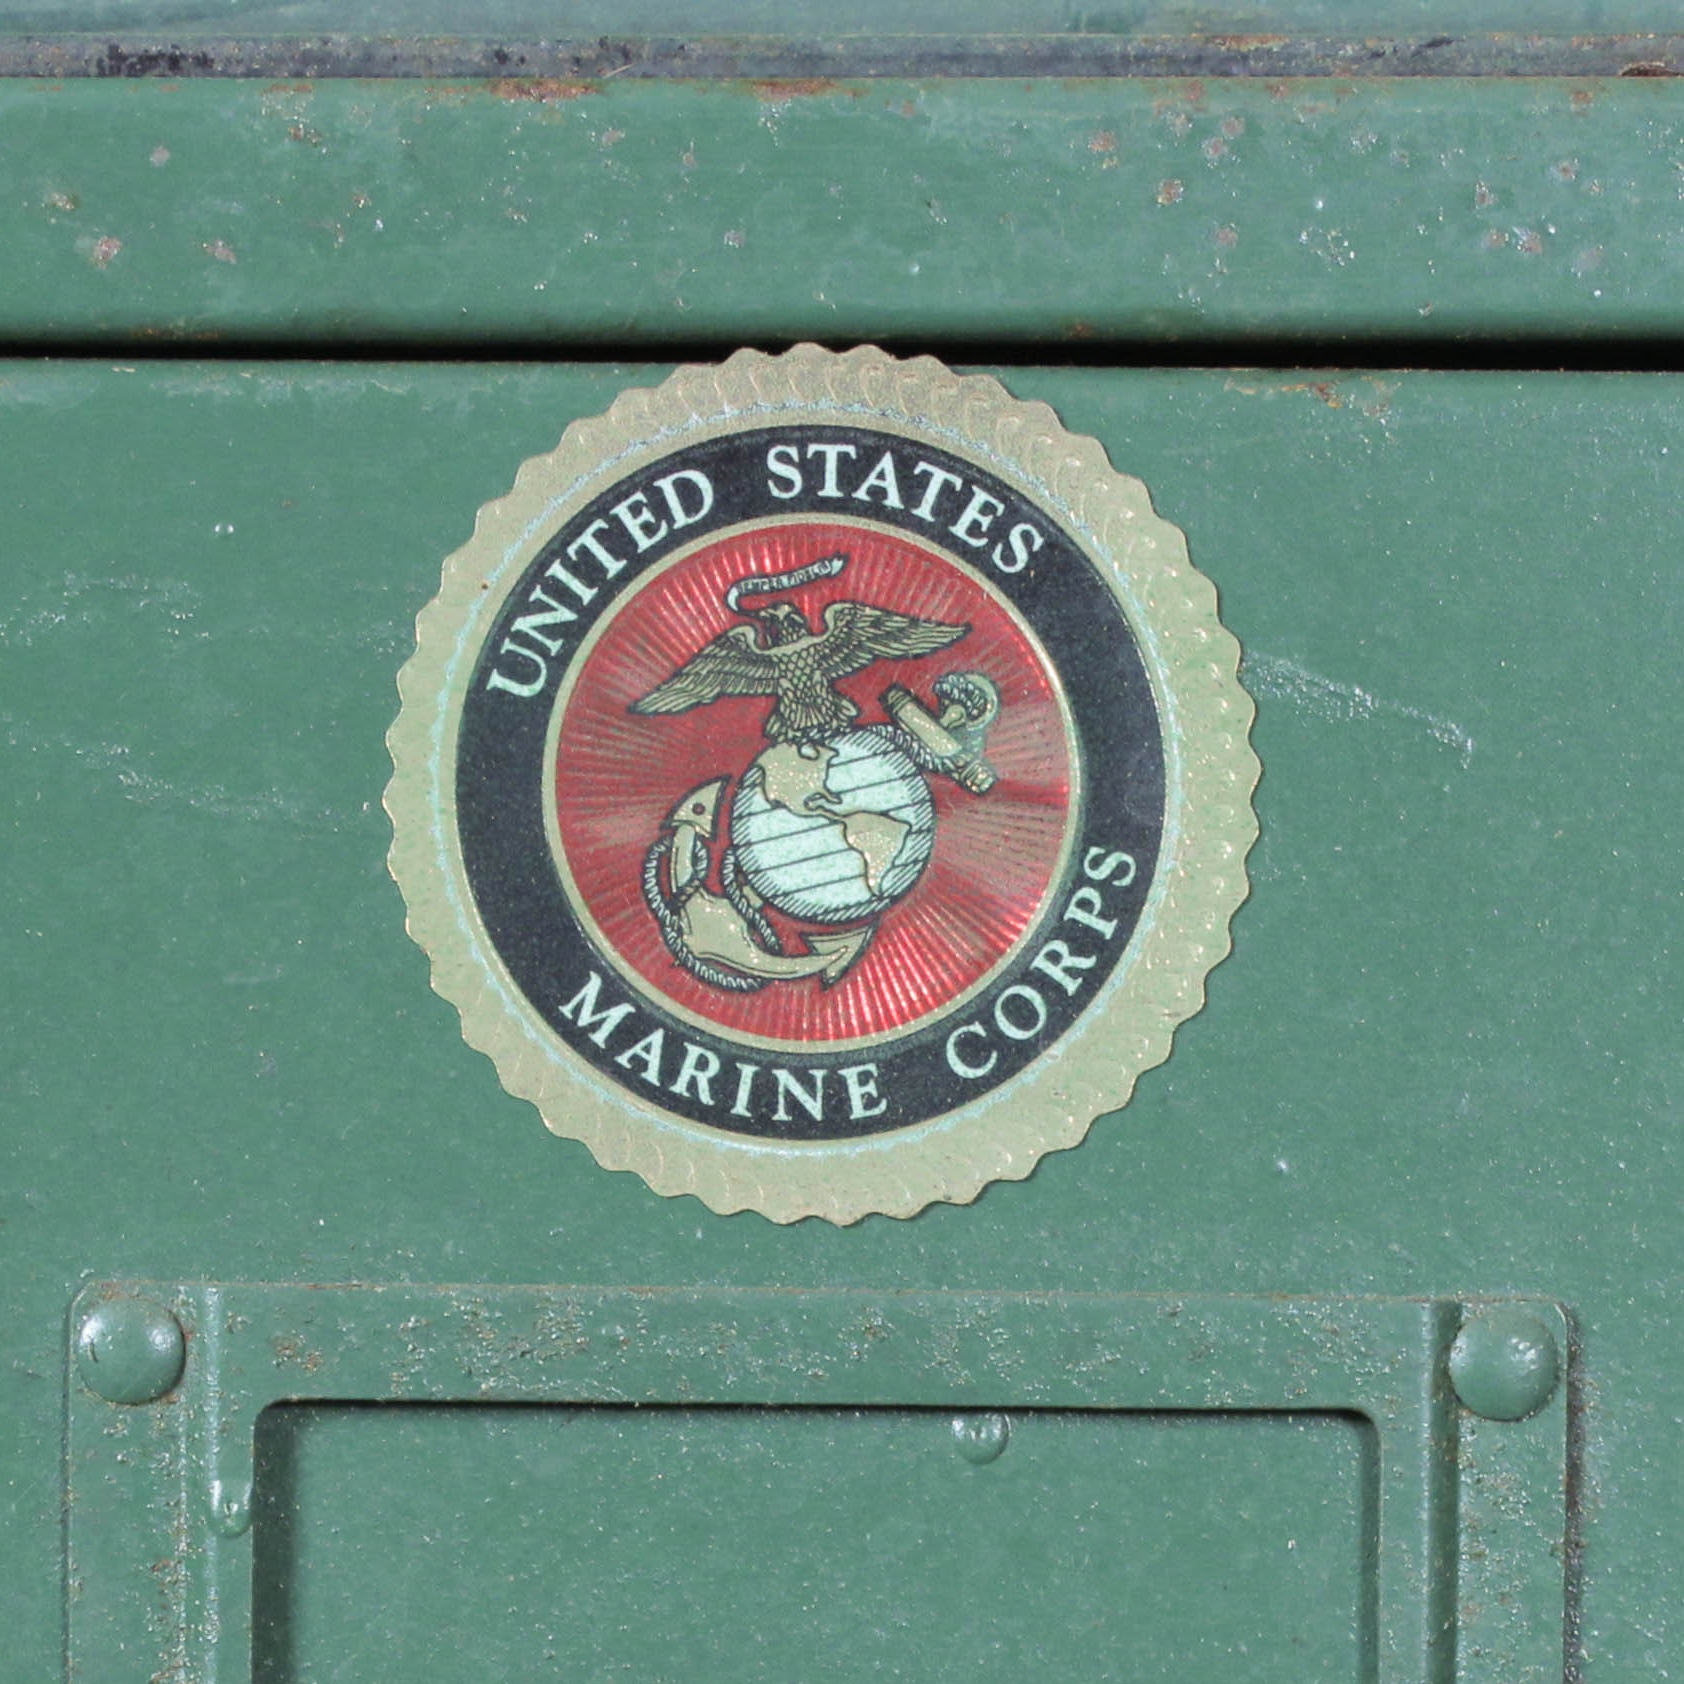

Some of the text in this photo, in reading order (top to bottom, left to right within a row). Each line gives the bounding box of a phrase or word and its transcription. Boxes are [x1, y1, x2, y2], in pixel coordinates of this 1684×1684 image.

[485, 442, 1046, 700] UNITED STATES
[557, 845, 1138, 1122] MARINE CORPS
